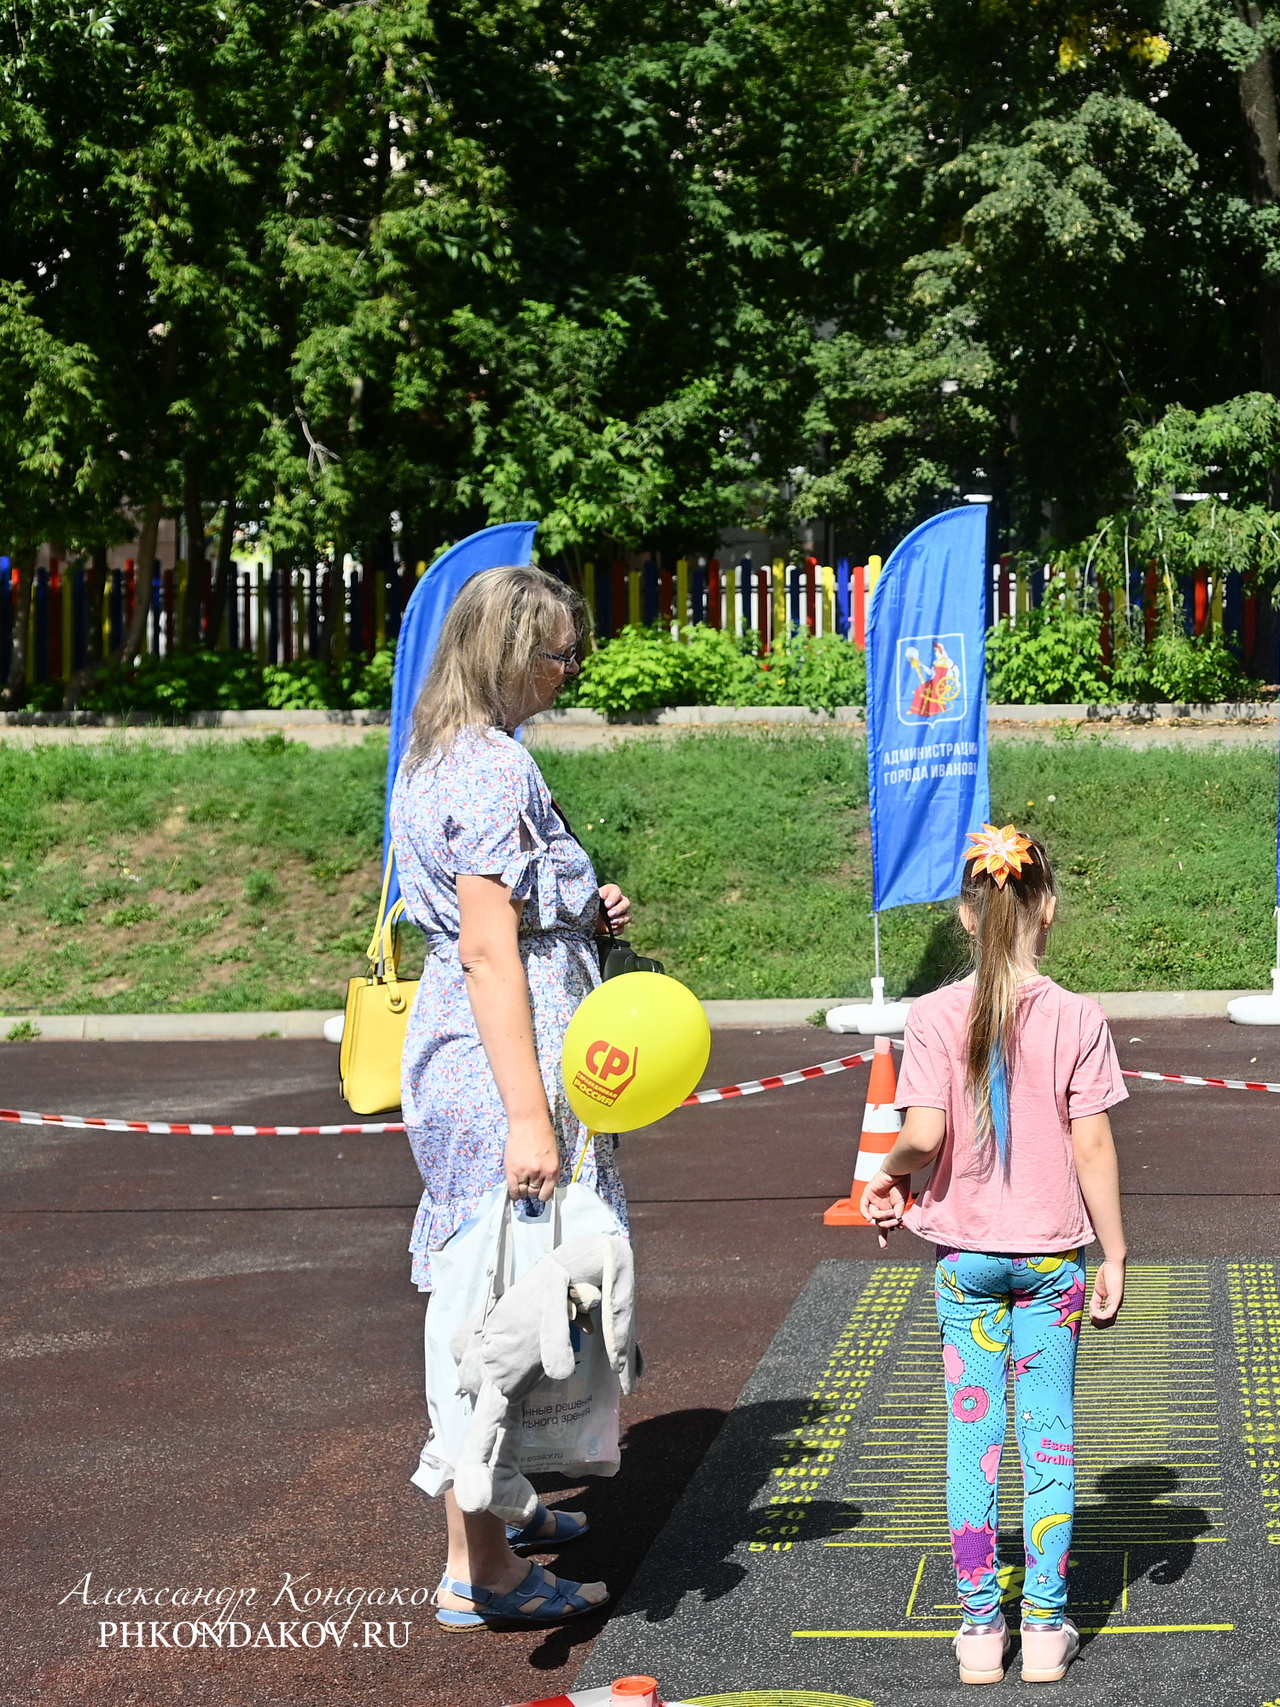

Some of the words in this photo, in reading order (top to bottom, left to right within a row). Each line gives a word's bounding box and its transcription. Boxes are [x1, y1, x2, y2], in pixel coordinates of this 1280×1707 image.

[884, 765, 929, 786] ГОРОДА
[931, 761, 977, 779] ИВАНОВ
[585, 1040, 630, 1081] СР
[573, 1078, 615, 1107] РОССИЯ
[830, 1349, 884, 1357] 200
[816, 1380, 866, 1388] 170
[811, 1391, 861, 1399] 160
[806, 1403, 857, 1411] 150
[799, 1414, 851, 1423] 140
[793, 1428, 846, 1436] 130
[785, 1440, 841, 1448] 120
[780, 1453, 835, 1462] 110
[771, 1467, 829, 1476] 100
[779, 1481, 819, 1490] 90
[769, 1496, 812, 1504] 80
[764, 1510, 806, 1519] 70
[756, 1526, 799, 1535] 60
[747, 1541, 793, 1552] 50
